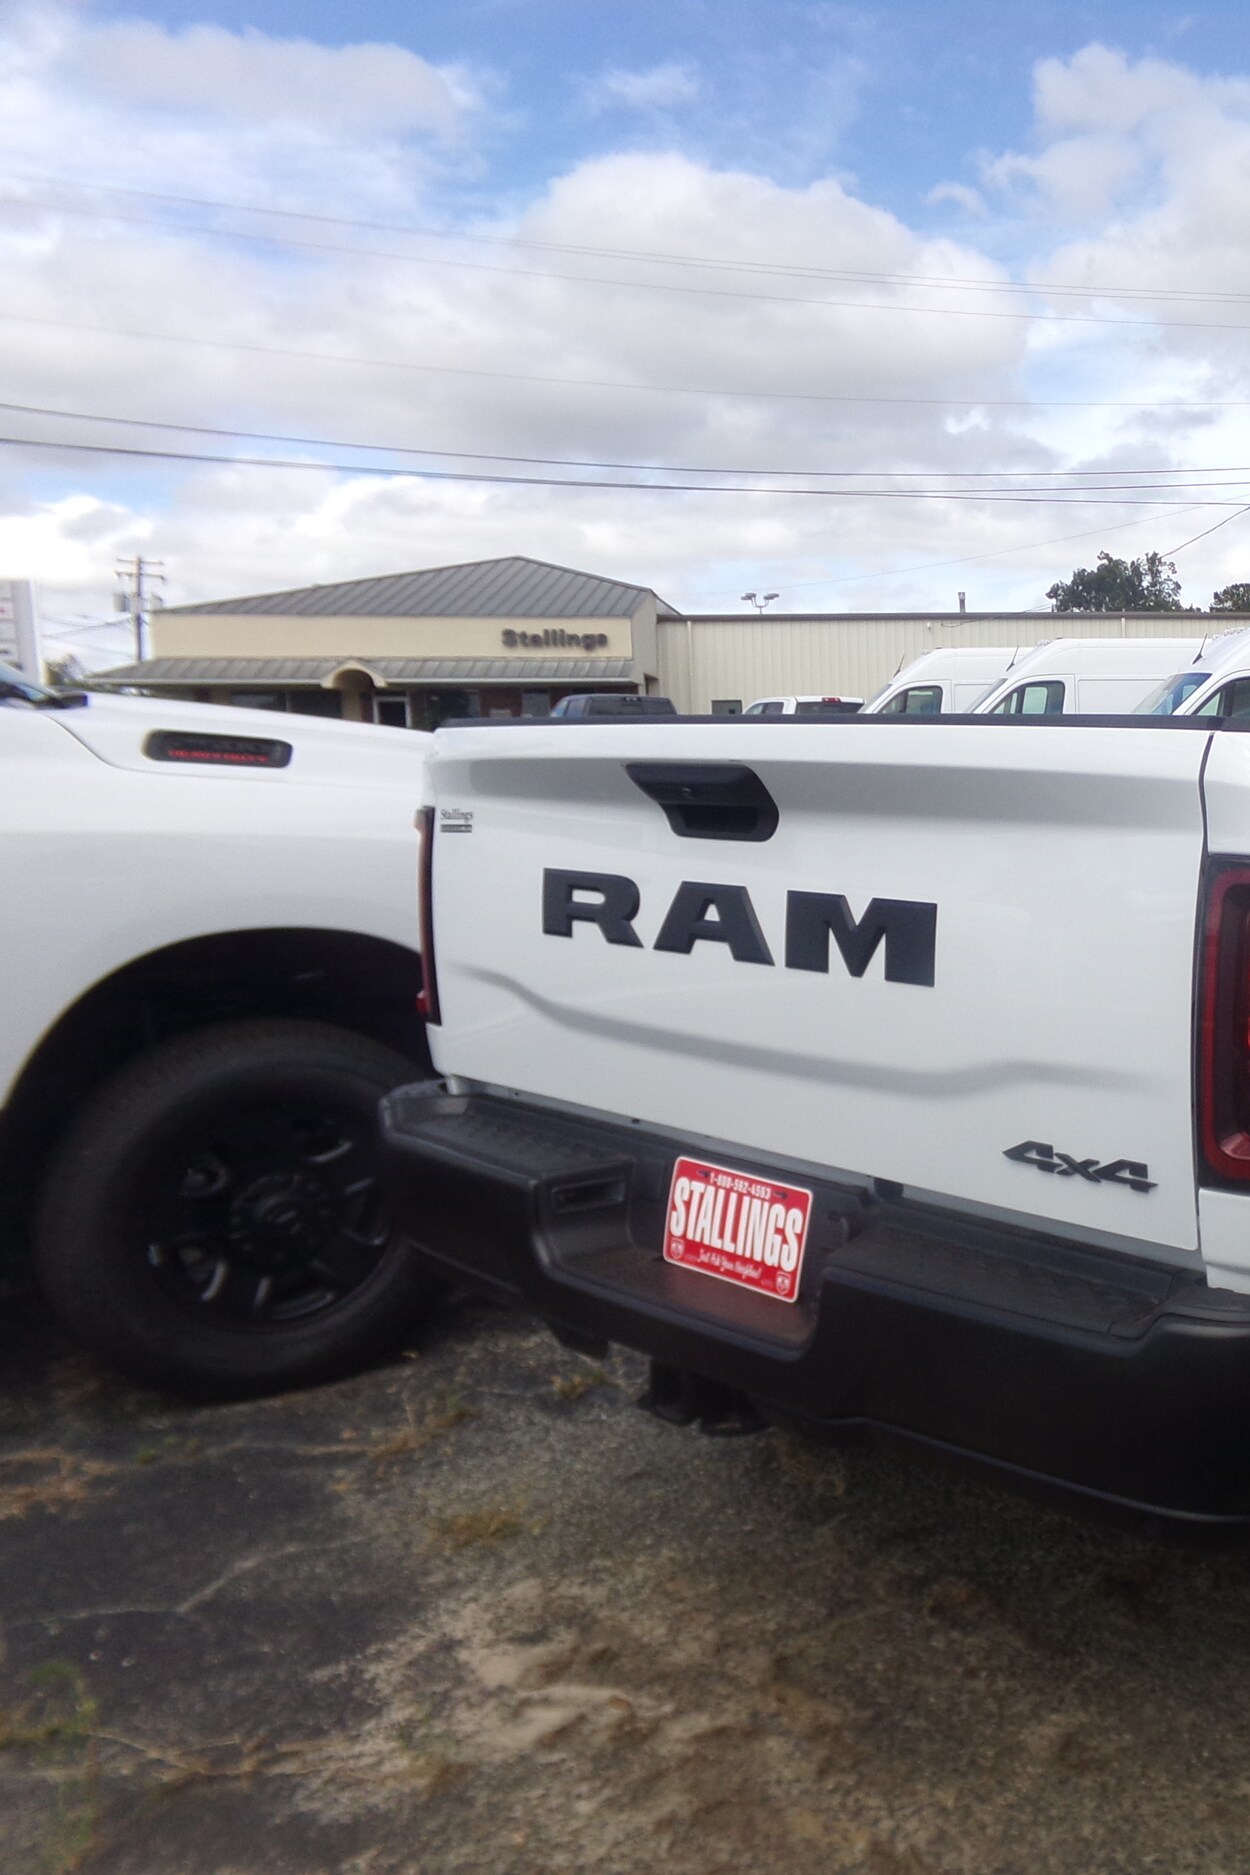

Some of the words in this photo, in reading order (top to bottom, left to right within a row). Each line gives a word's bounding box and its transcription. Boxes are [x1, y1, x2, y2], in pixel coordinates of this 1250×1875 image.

[501, 628, 609, 652] Stallings
[542, 867, 938, 988] RAM
[669, 1177, 804, 1272] STALLINGS
